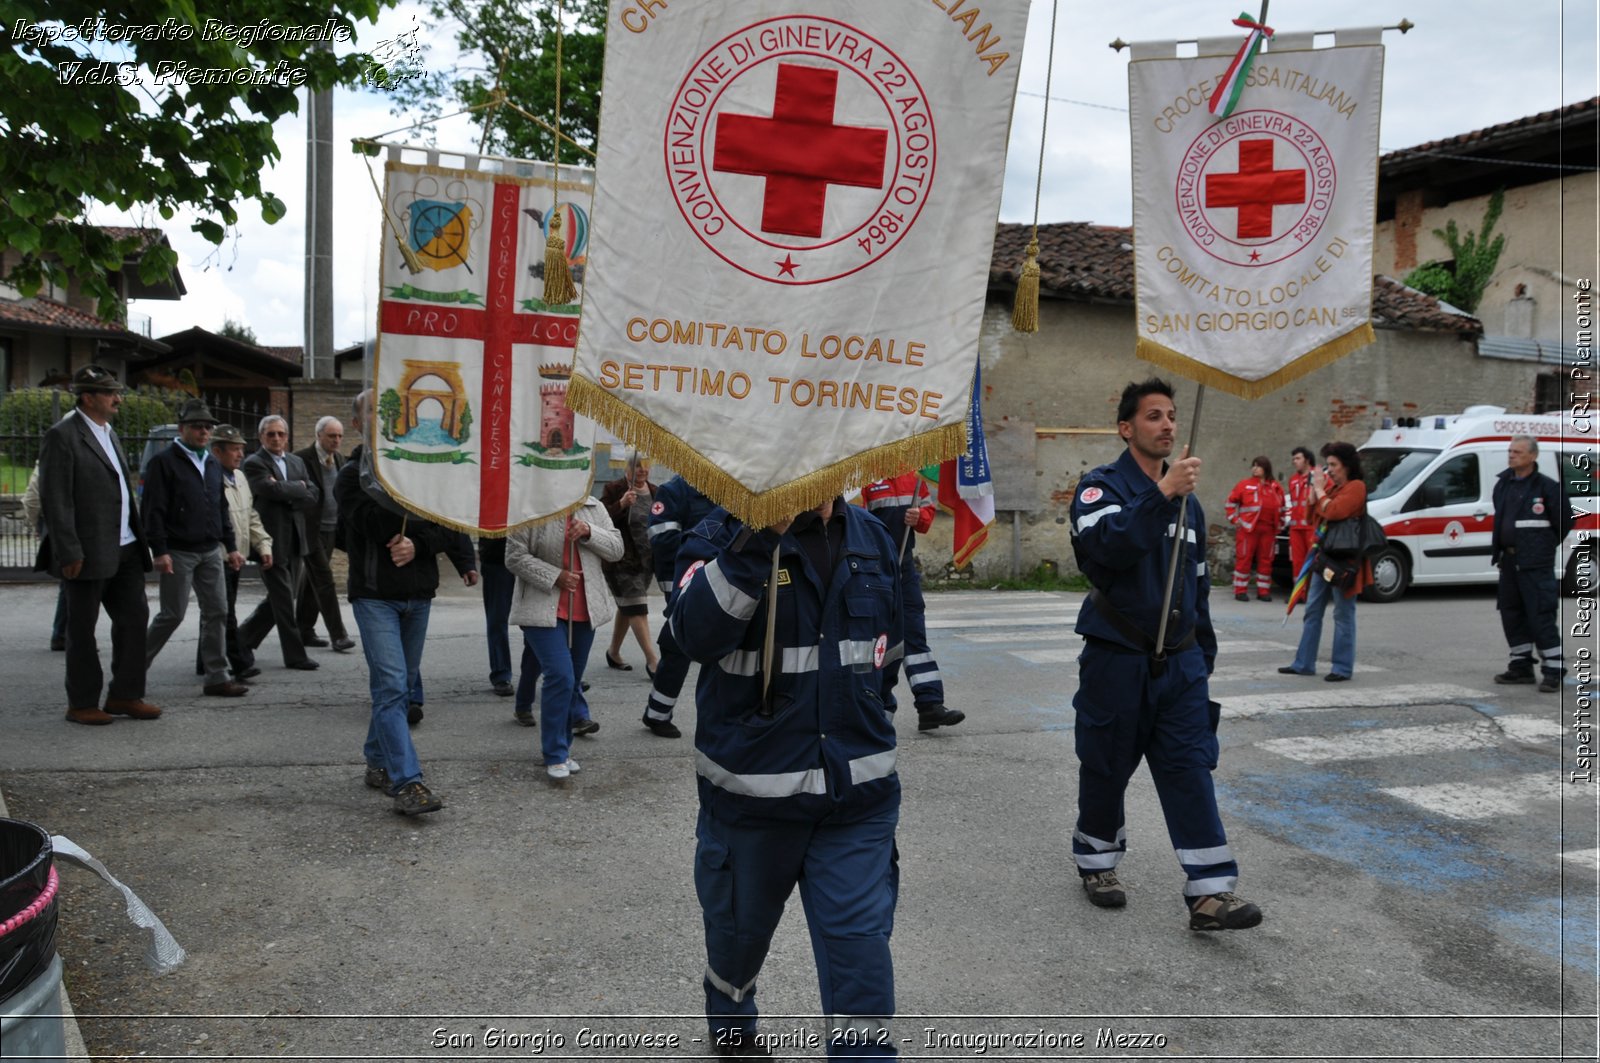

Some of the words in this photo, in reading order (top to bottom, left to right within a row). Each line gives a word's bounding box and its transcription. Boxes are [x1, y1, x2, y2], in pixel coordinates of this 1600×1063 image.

[727, 37, 756, 65] DI
[760, 25, 873, 71] GINEVRA
[873, 61, 907, 94] 22
[1154, 80, 1212, 134] CROCE
[1214, 65, 1280, 90] SSA
[1283, 68, 1358, 121] ITALIANA
[672, 55, 732, 236] CONVENZIONE
[1207, 126, 1224, 142] DI
[1225, 115, 1293, 136] GINEVRA
[1293, 128, 1314, 148] 22
[894, 97, 930, 205] AGOSTO
[1180, 141, 1216, 247] CONVENZIONE
[1310, 145, 1334, 212] AGOSTO
[857, 209, 905, 255] 1864
[1293, 213, 1322, 243] 1864
[1156, 245, 1251, 307] COMITATO
[1257, 255, 1333, 307] LOCALE
[1326, 236, 1350, 259] DI
[407, 309, 458, 333] PRO
[625, 316, 788, 356] COMITATO
[801, 332, 927, 367] LOCALE
[1146, 313, 1191, 334] SAN
[1195, 310, 1289, 332] GIORGIO
[489, 354, 505, 470] CANAVESE
[599, 360, 752, 400] SETTIMO
[767, 376, 944, 420] TORINESE
[1493, 420, 1528, 434] CROCE
